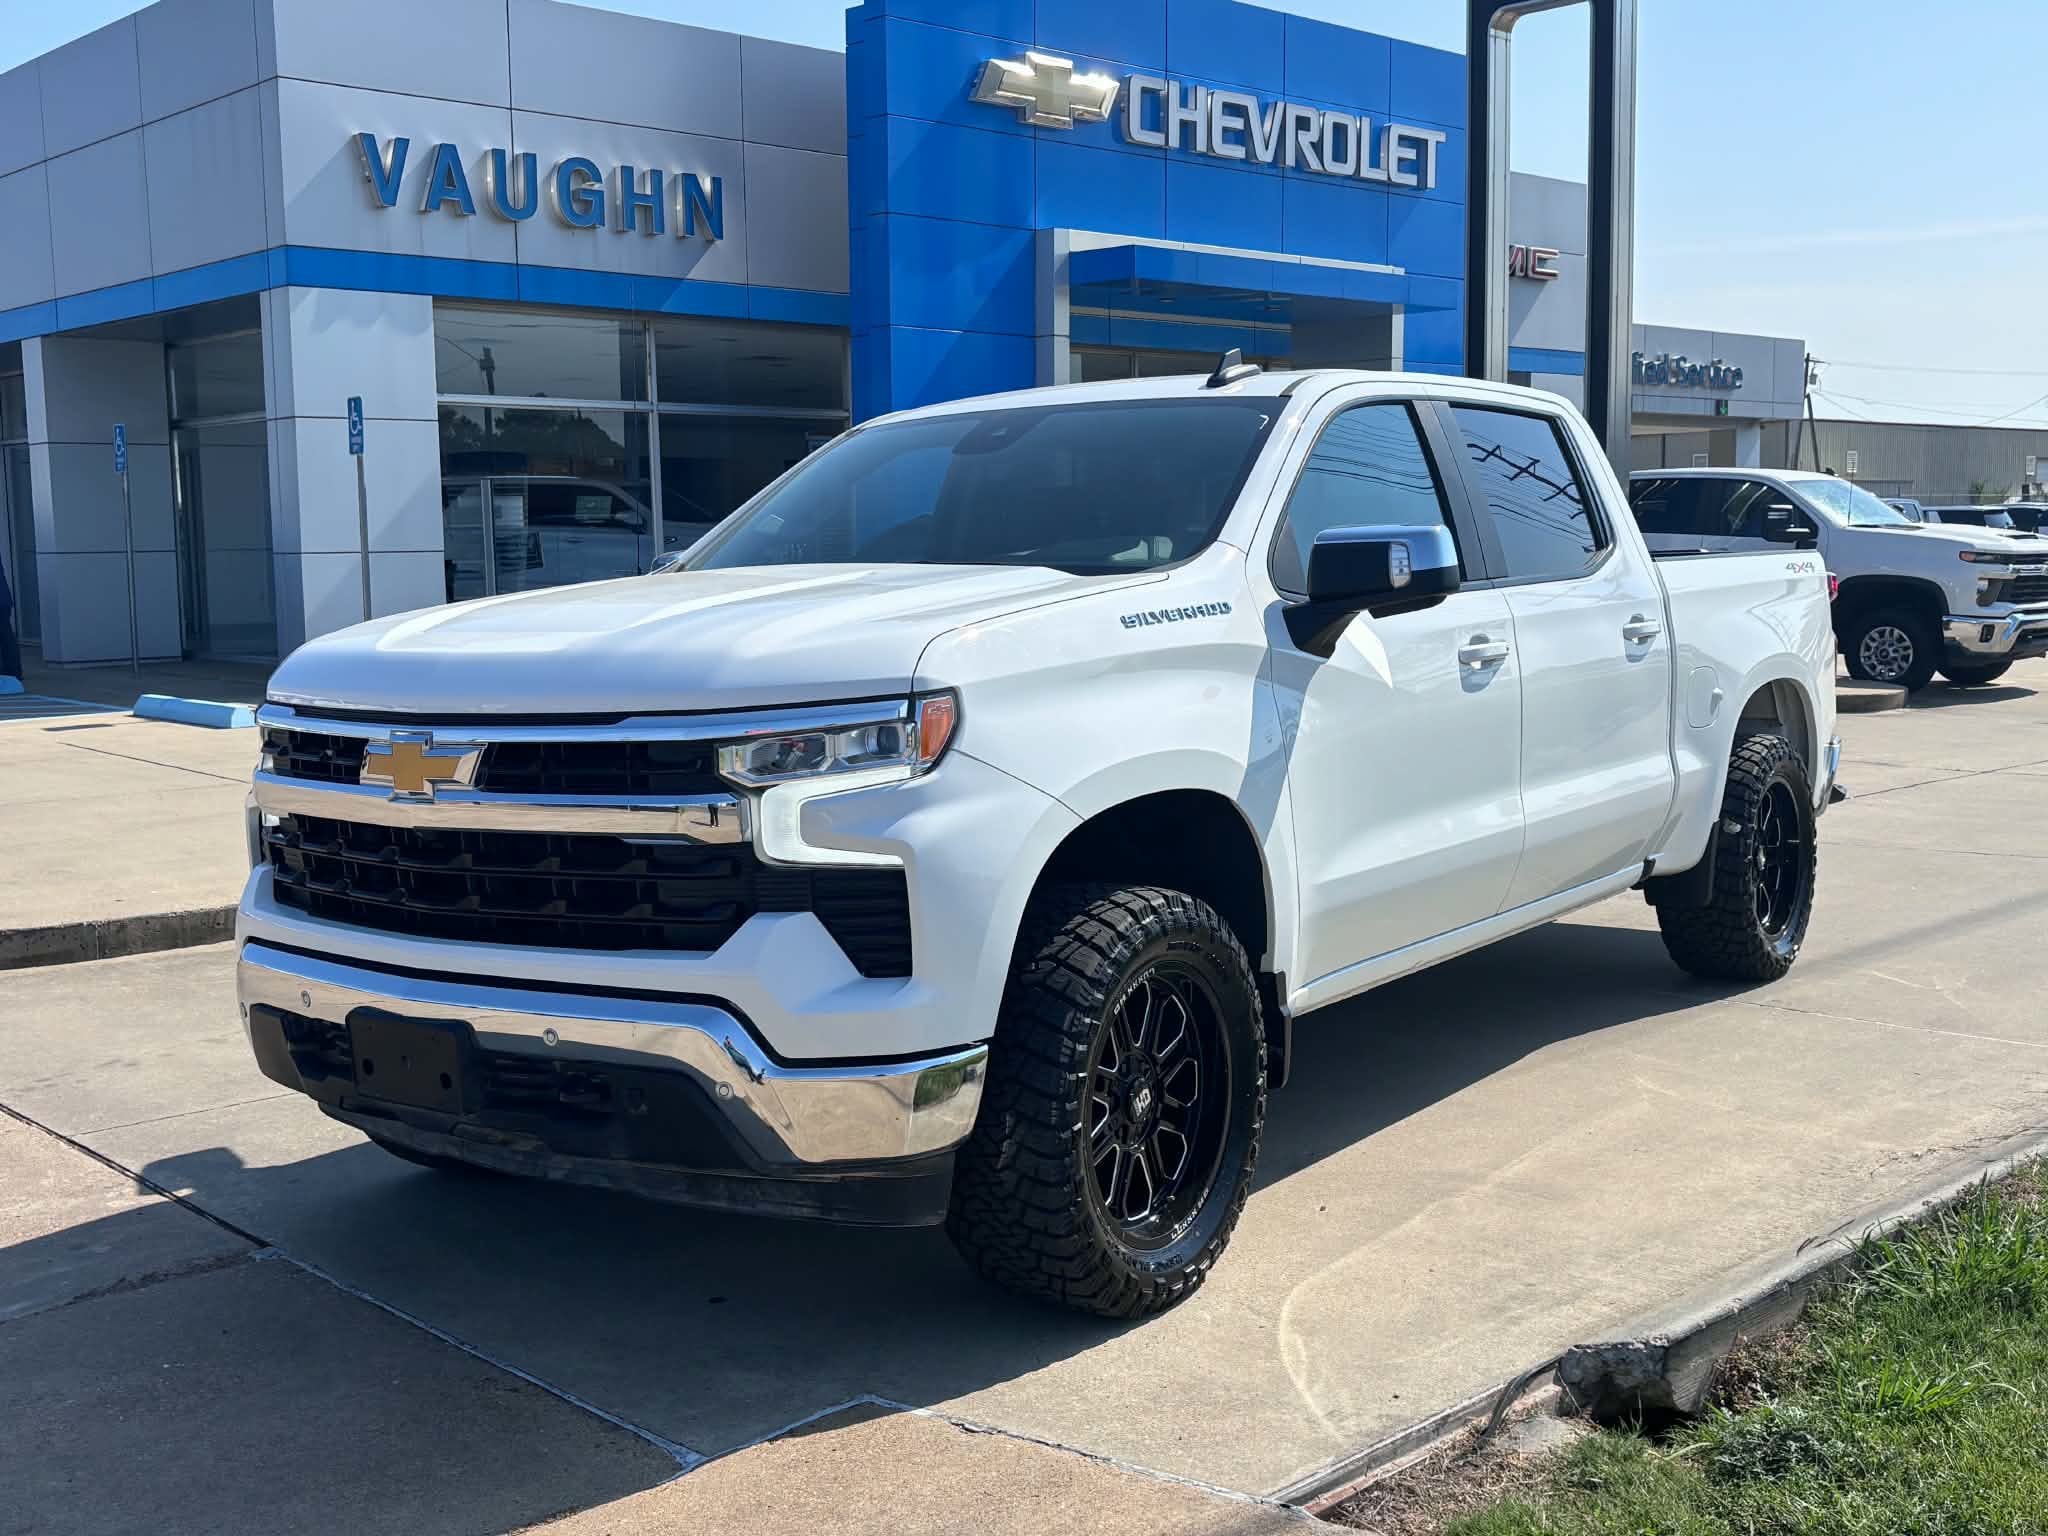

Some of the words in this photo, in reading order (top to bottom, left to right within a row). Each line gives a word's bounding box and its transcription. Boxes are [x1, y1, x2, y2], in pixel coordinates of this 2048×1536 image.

[1120, 74, 1447, 189] CHEVROLET
[353, 133, 724, 241] VAUGHN
[1509, 245, 1560, 280] MC
[1670, 355, 1743, 389] Service
[1120, 601, 1232, 629] SILVERADO
